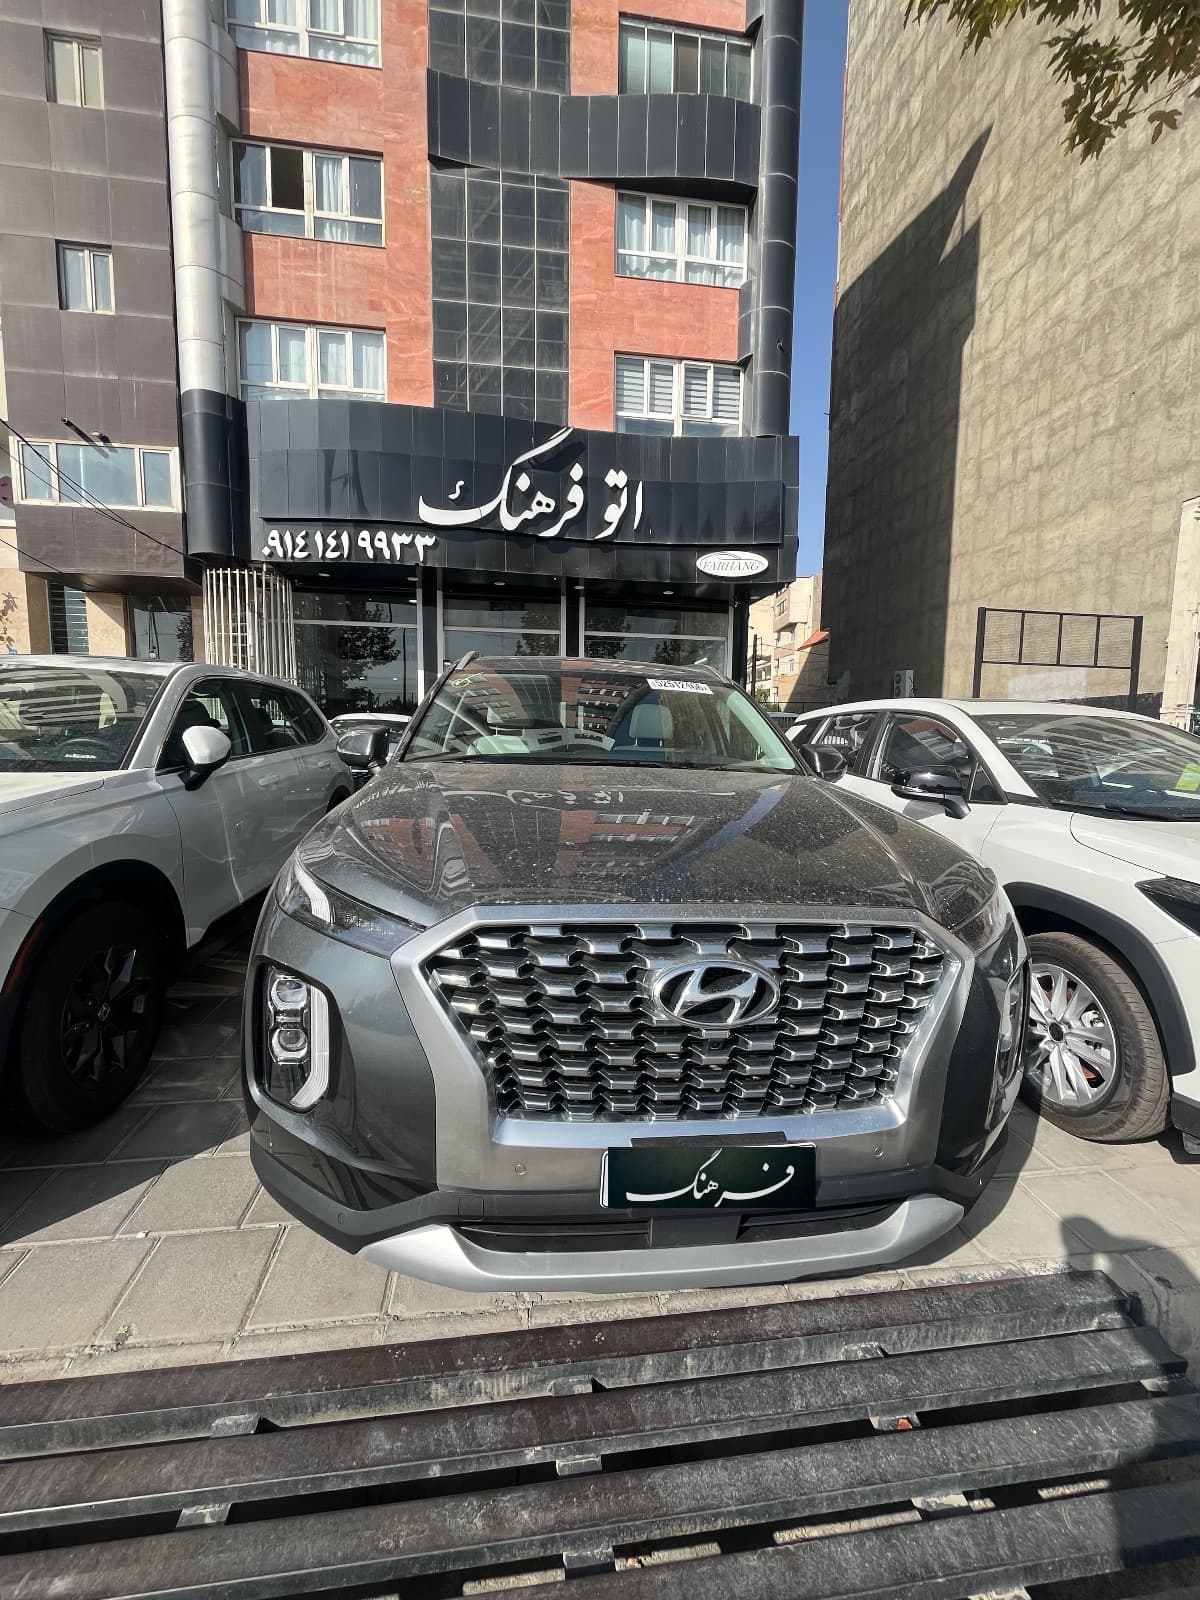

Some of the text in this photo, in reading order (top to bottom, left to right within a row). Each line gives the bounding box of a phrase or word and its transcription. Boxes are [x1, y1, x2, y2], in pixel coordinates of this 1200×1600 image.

[418, 427, 643, 540] اتو فرهنگ
[702, 561, 760, 571] FARHANG
